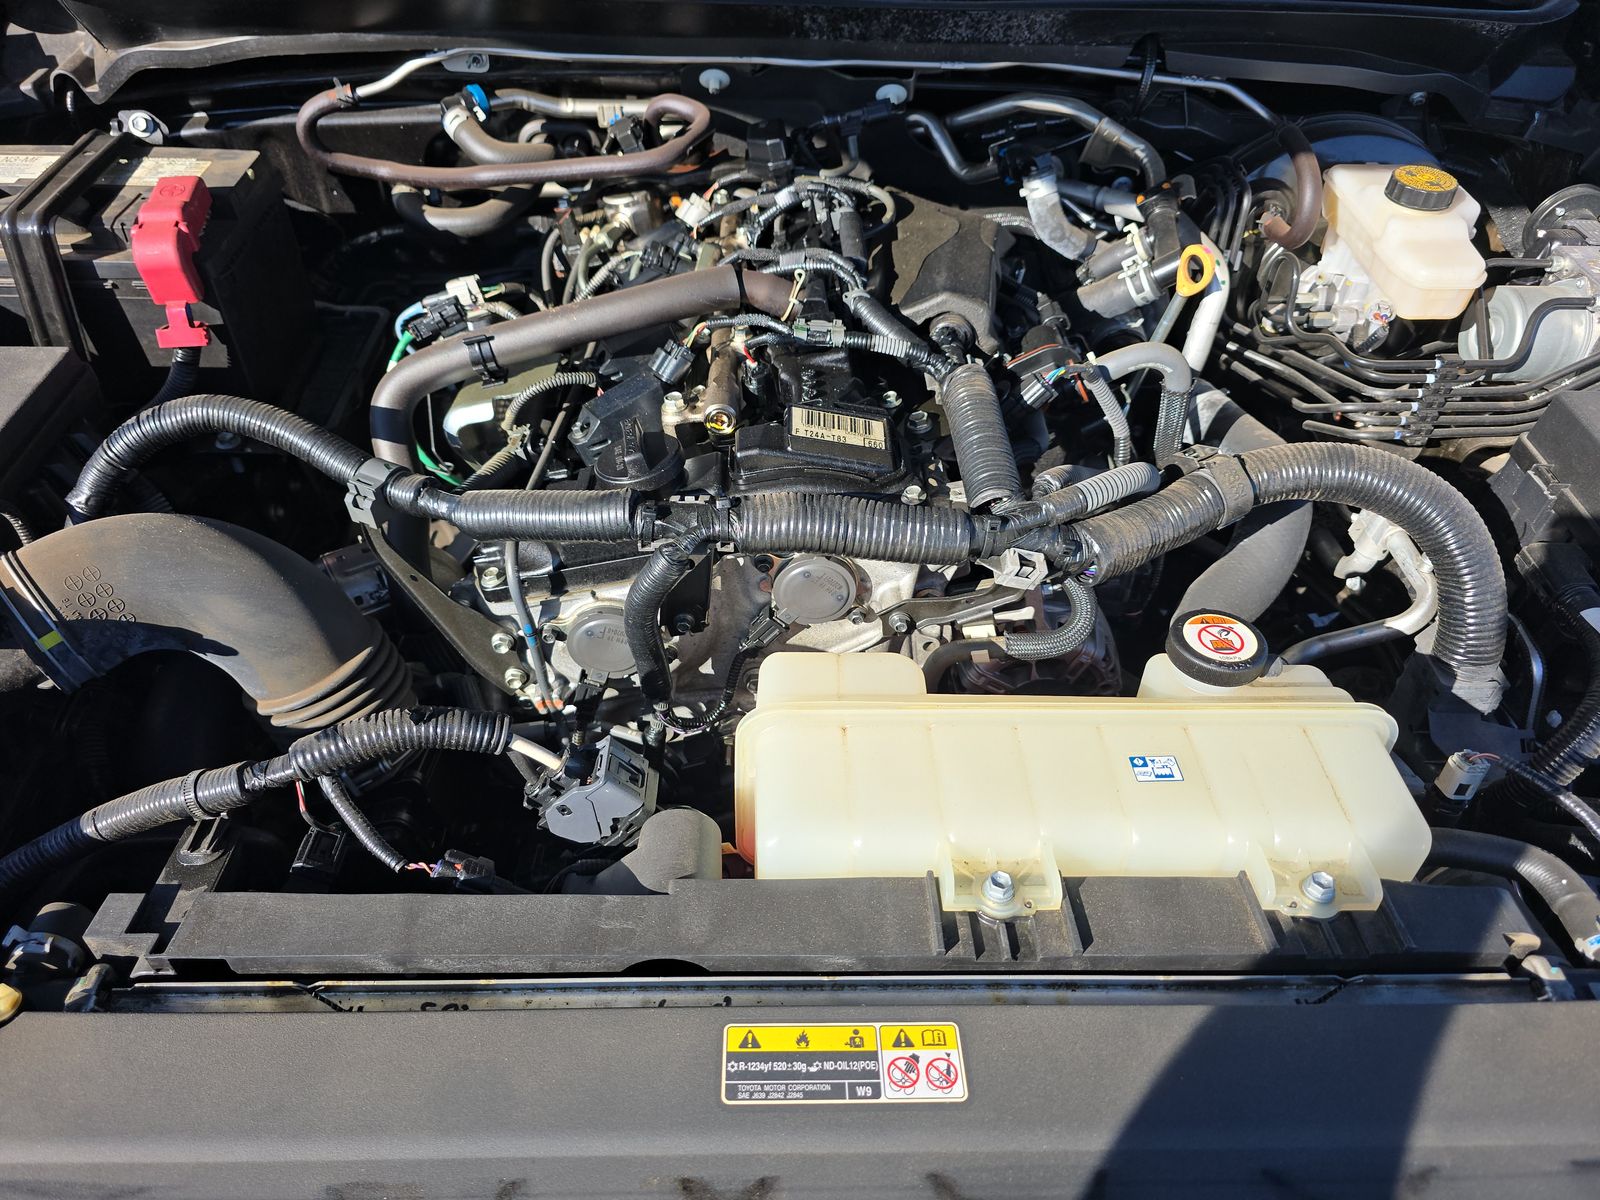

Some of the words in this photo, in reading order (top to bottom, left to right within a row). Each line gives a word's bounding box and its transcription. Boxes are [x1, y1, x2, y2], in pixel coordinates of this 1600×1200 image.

[739, 1061, 772, 1073] R-1234yf
[773, 1061, 807, 1073] 520±30g
[823, 1060, 879, 1071] ND-OIL12(POE)
[787, 1083, 832, 1091] CORPORATION
[856, 1085, 873, 1097] W9
